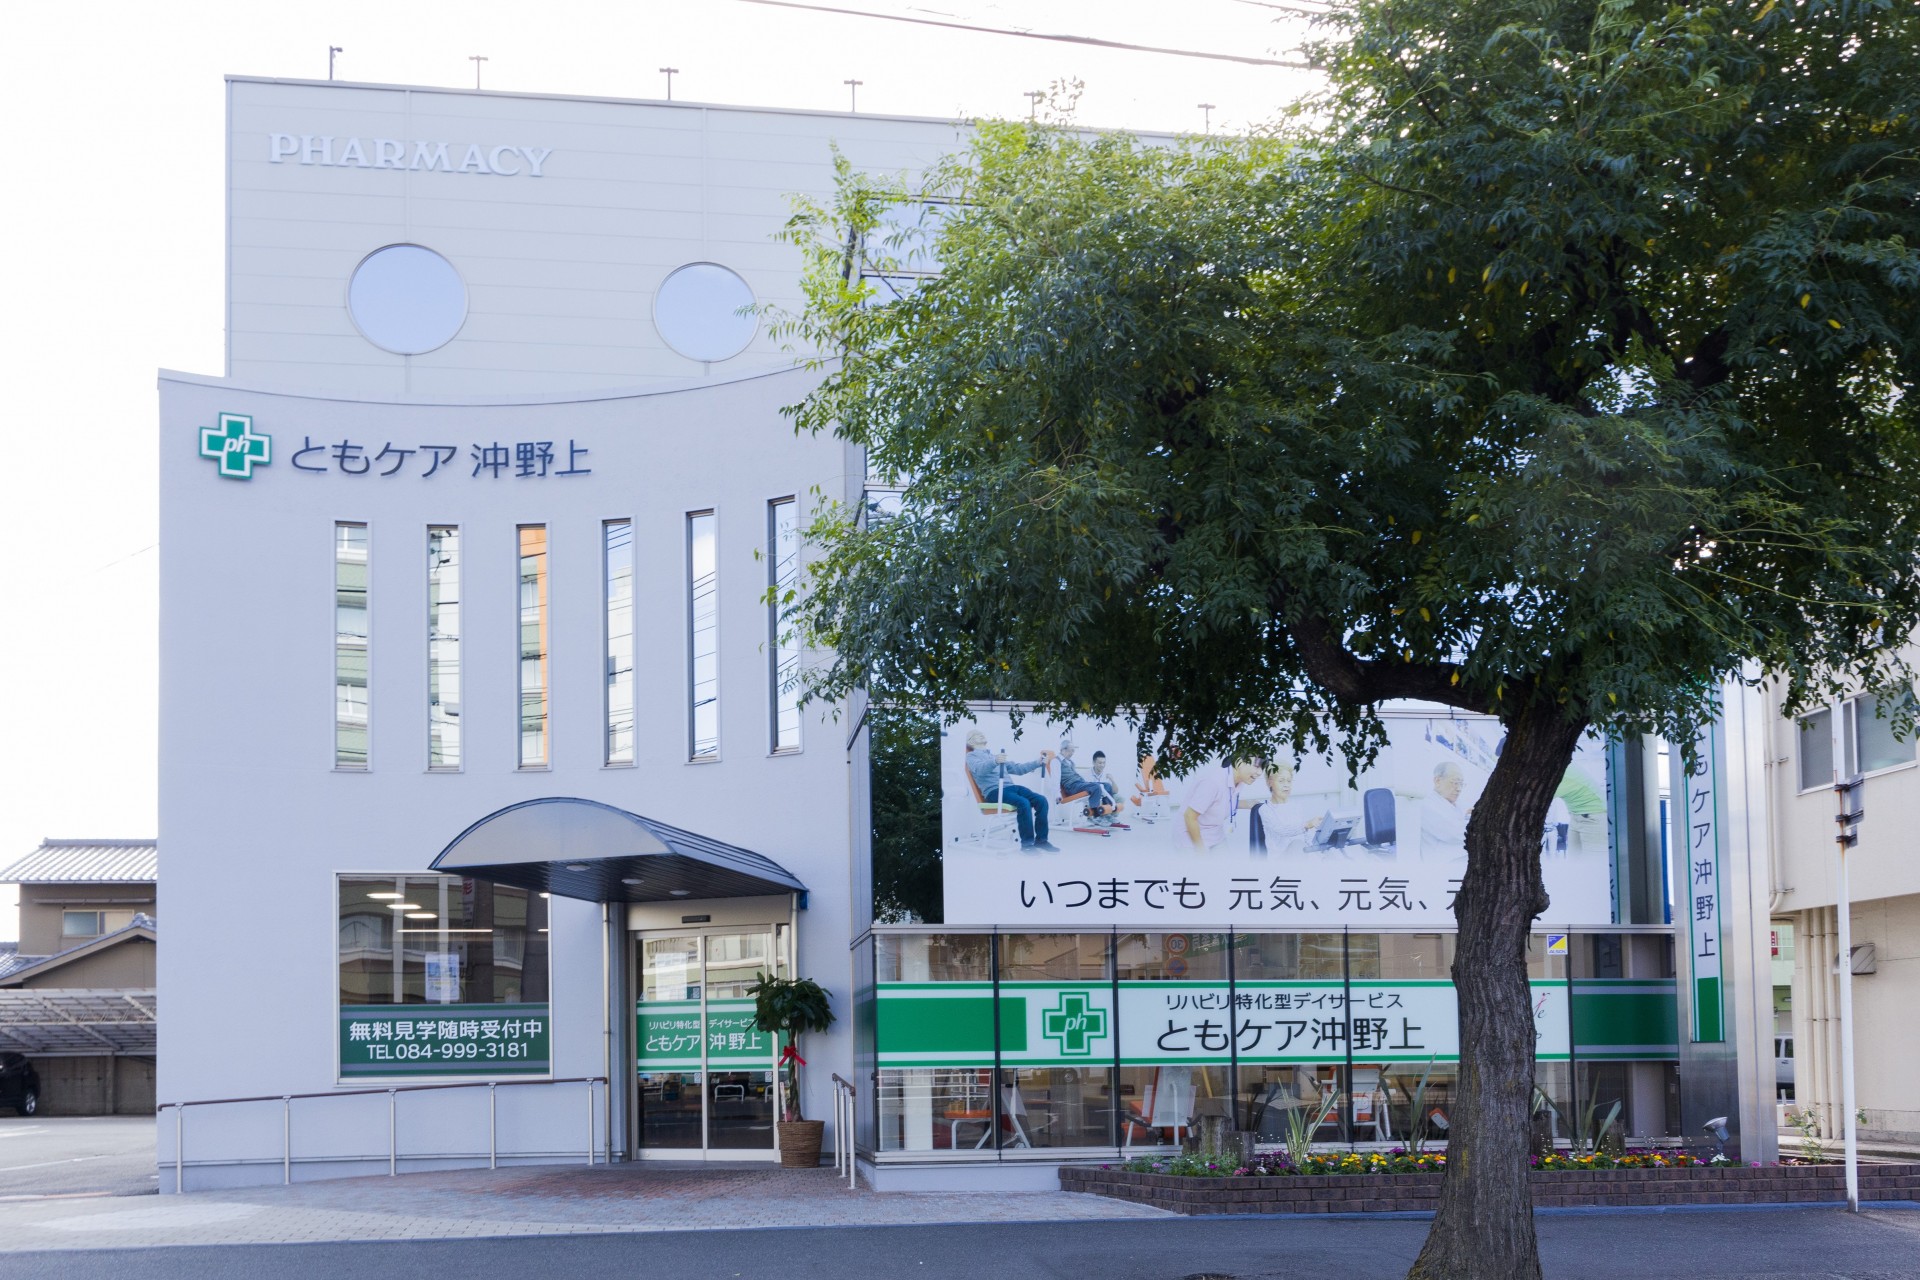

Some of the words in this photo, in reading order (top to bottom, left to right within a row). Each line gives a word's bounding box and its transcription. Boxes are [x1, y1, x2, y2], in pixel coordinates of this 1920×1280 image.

[268, 132, 552, 177] PHARMACY
[223, 434, 251, 456] ph
[291, 436, 458, 479] ともケア
[471, 439, 592, 480] 沖野上
[1020, 877, 1206, 910] いつまでも
[1166, 992, 1404, 1011] リハビリ特化型デイサービス
[349, 1019, 543, 1041] 無料見学随時受付中
[1064, 1013, 1087, 1035] ph
[1156, 1016, 1425, 1052] ともケア沖野上
